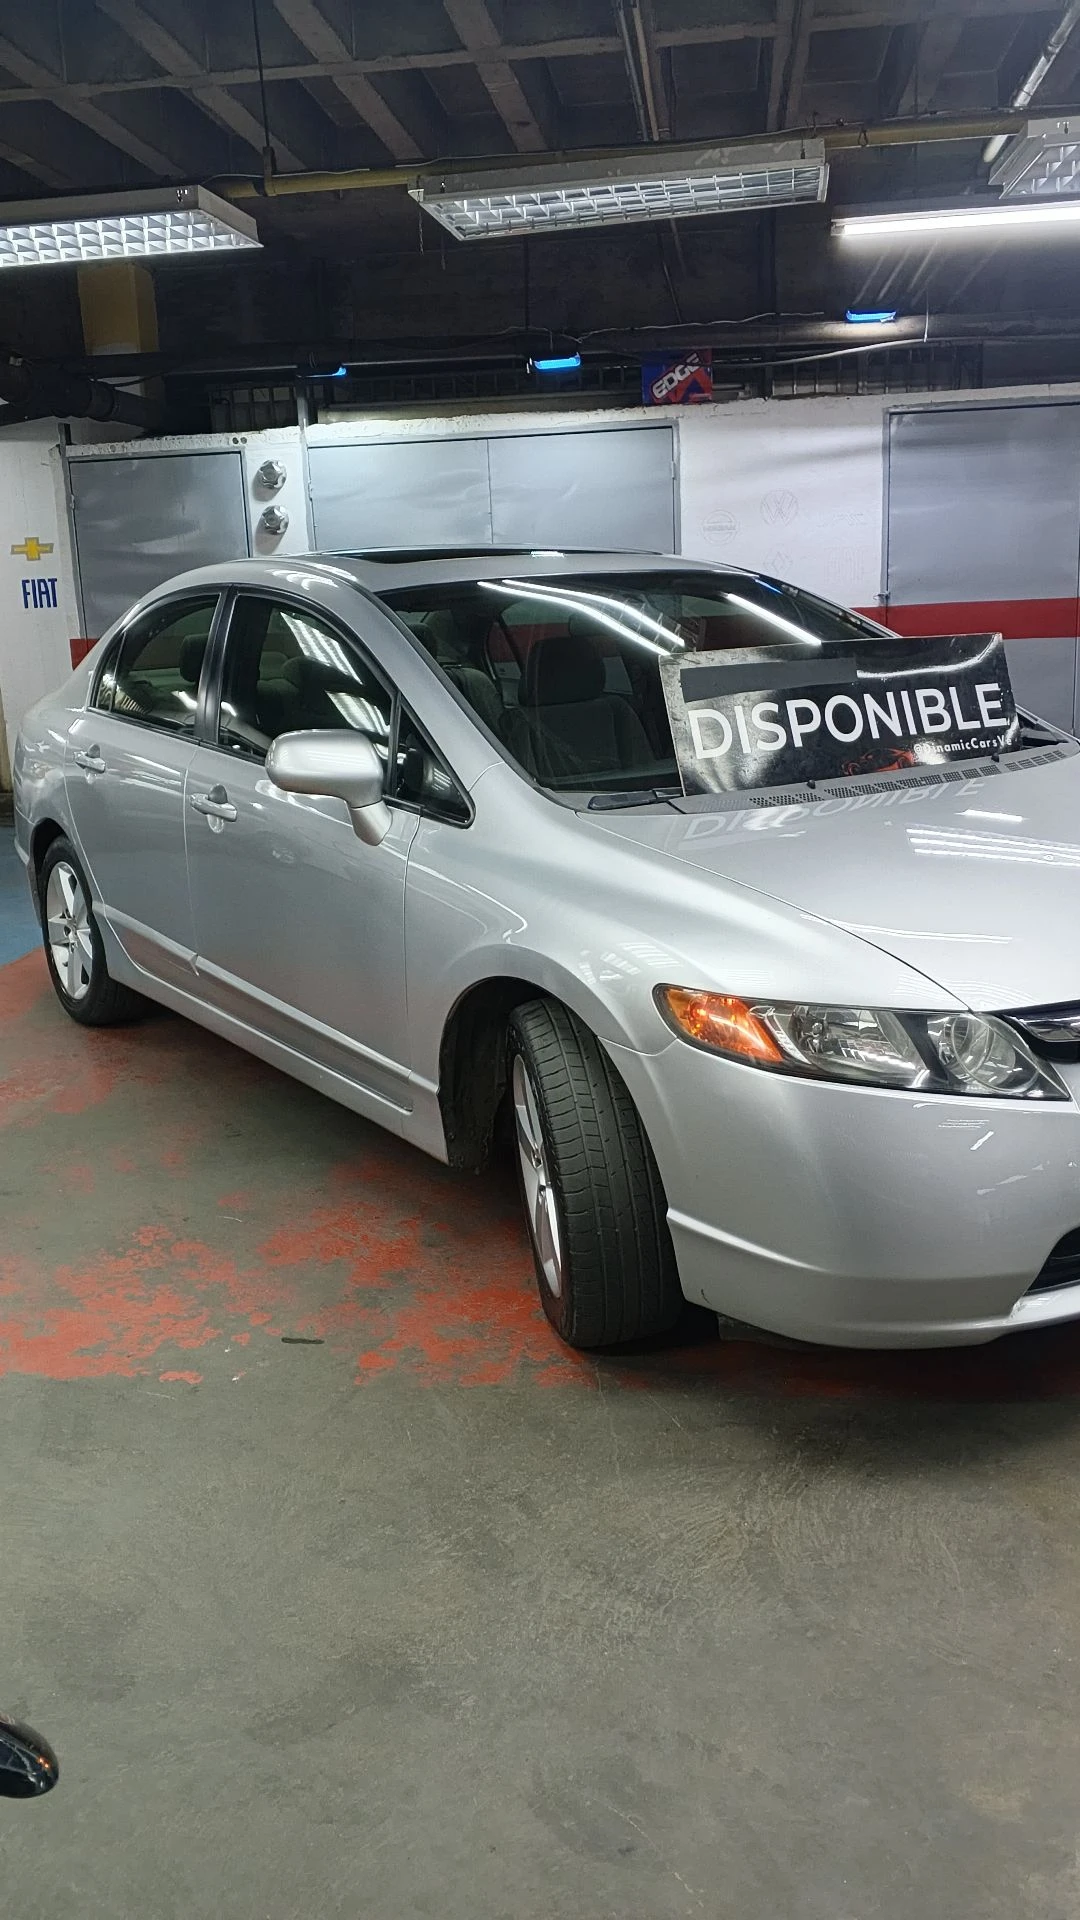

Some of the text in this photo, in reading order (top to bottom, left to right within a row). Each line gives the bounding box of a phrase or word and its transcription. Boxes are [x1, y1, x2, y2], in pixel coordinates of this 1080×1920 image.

[652, 352, 701, 399] EDGE
[21, 577, 58, 609] FIAT
[688, 682, 1010, 759] DISPONIBLE
